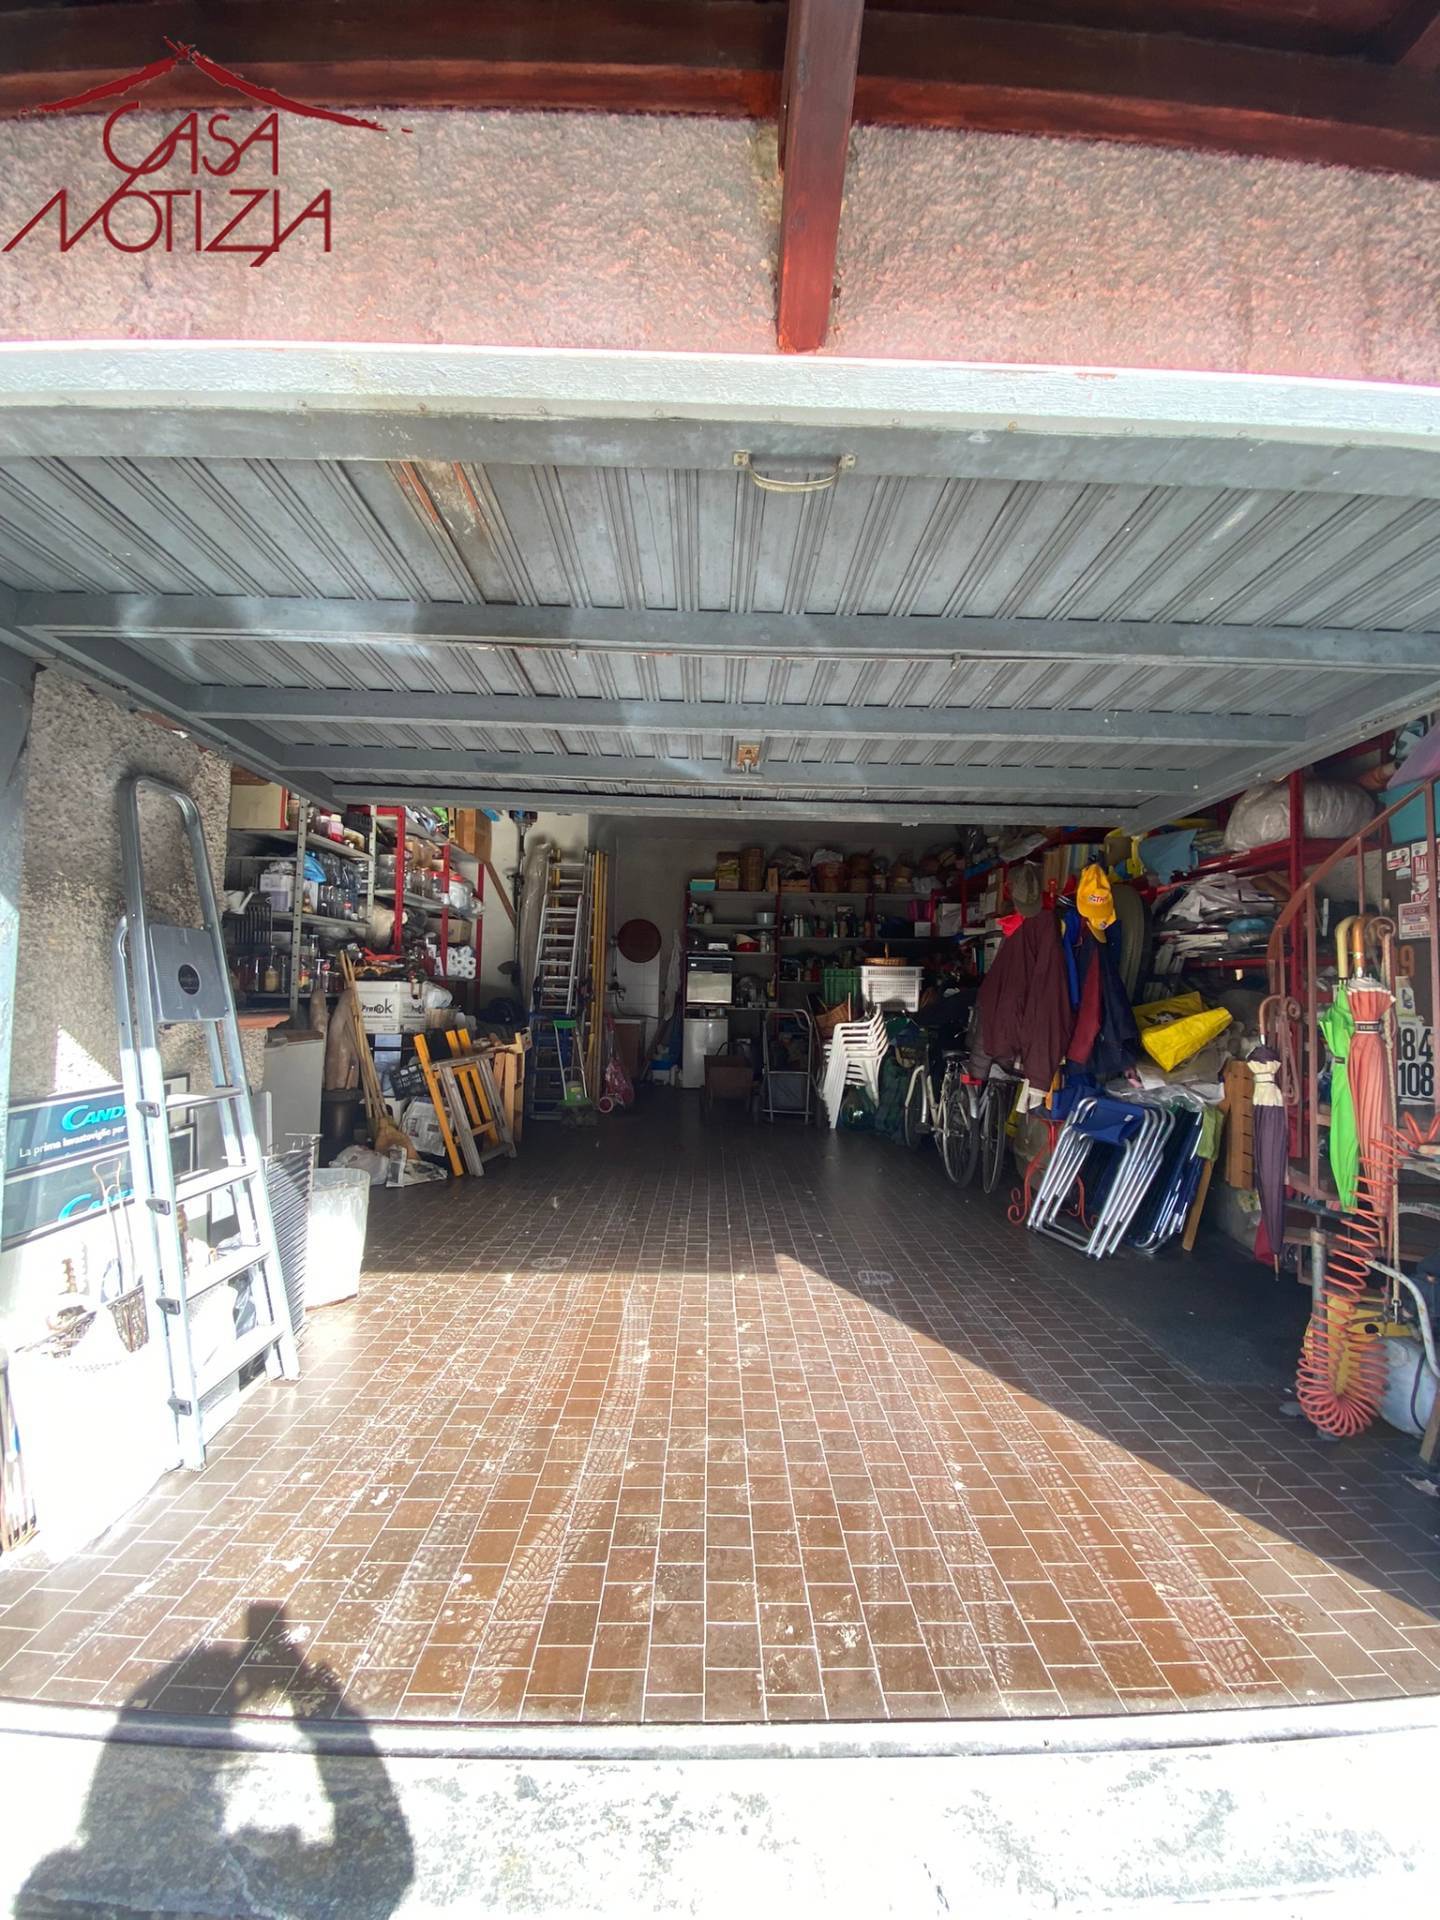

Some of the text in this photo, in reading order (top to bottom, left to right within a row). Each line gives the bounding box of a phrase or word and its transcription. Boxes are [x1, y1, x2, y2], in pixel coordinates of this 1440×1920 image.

[1398, 1062, 1434, 1096] 108
[62, 1105, 126, 1131] CAND
[19, 1148, 31, 1157] La
[33, 1141, 61, 1156] prima
